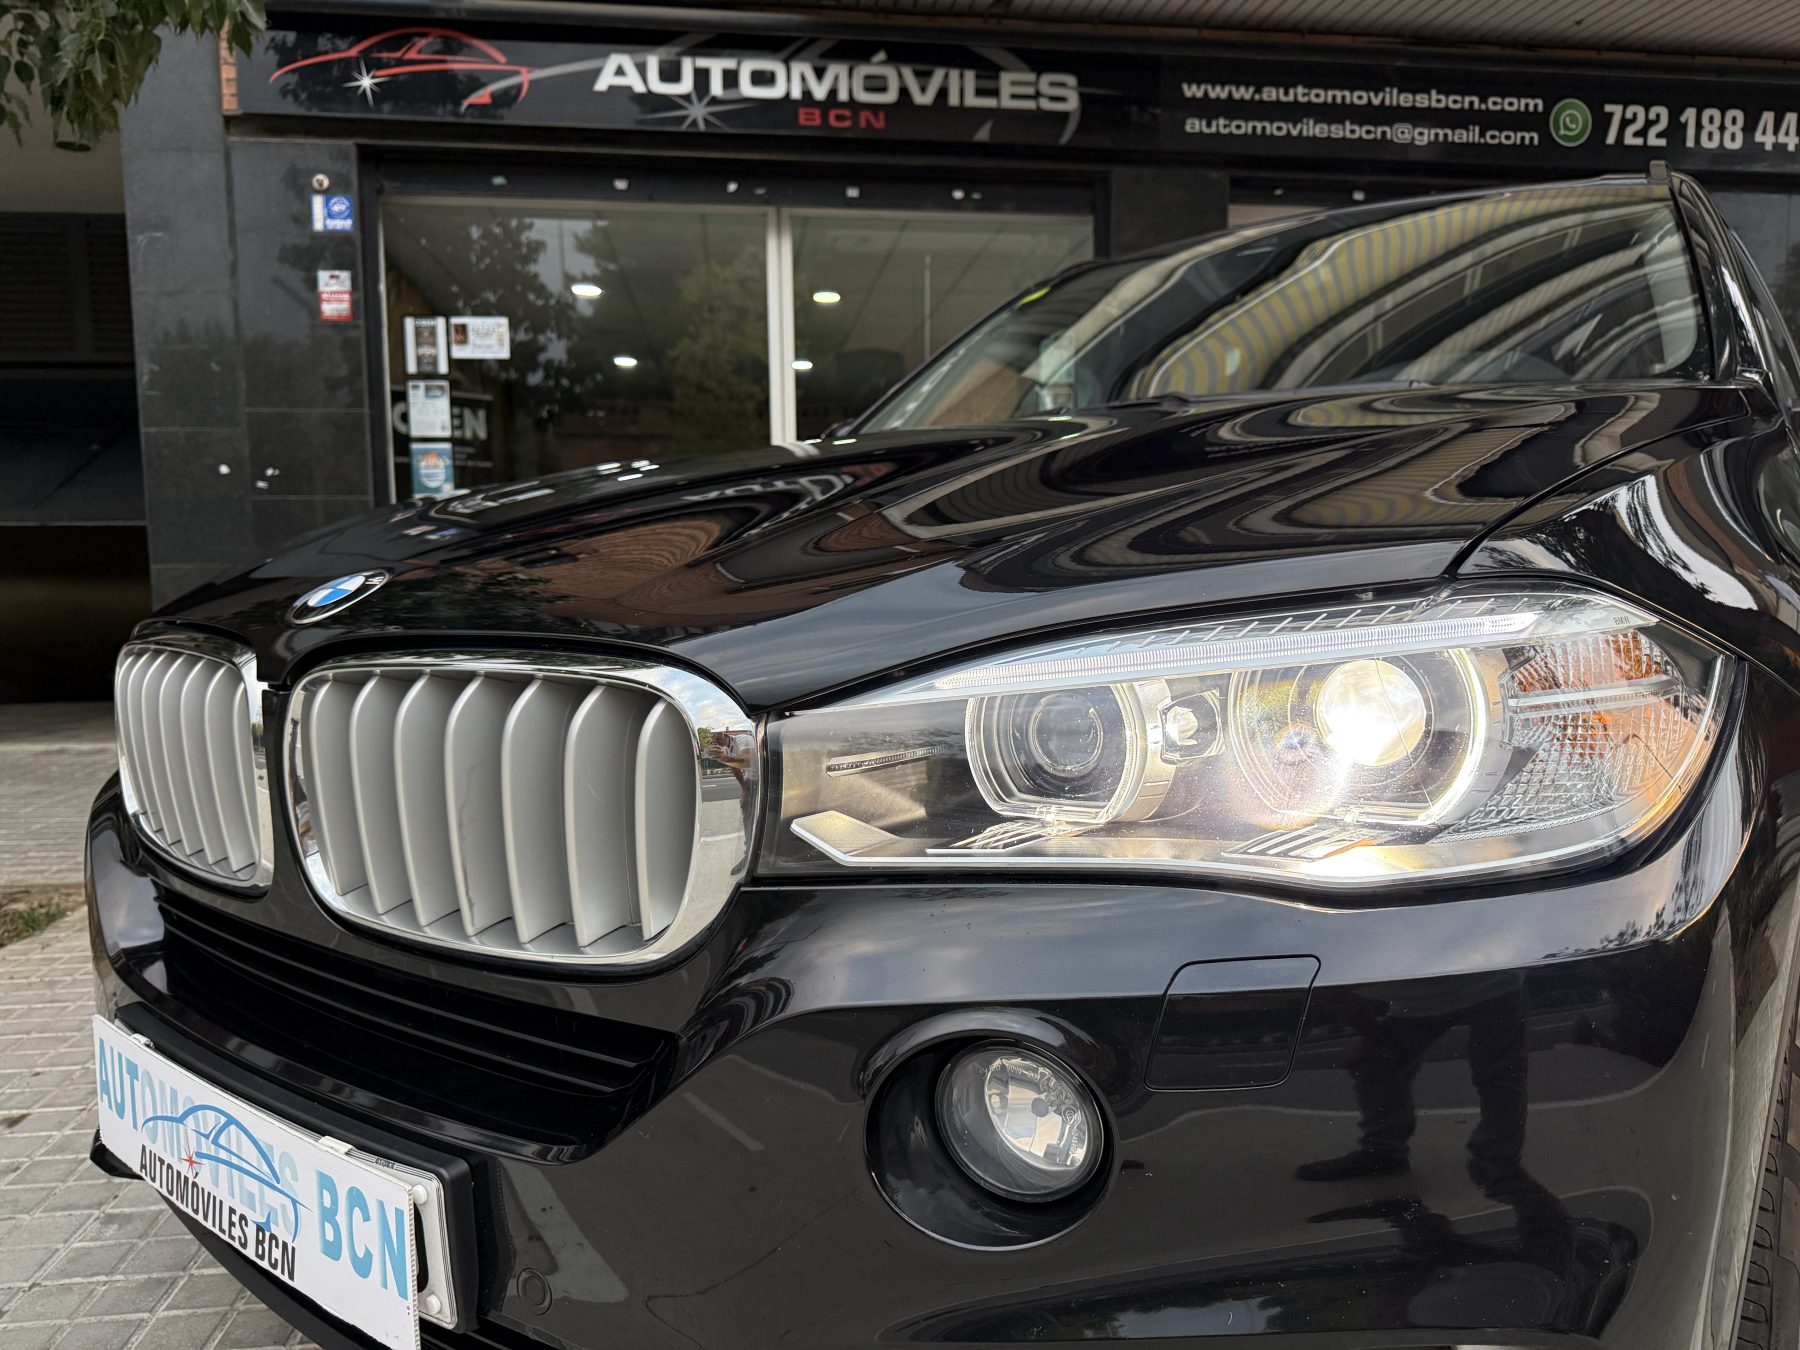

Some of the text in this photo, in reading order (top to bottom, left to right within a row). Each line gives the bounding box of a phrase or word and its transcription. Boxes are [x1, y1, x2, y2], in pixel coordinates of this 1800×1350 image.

[593, 50, 1080, 112] AUTOMÓVILES
[1181, 81, 1544, 114] www.automovilesbcn.com
[797, 107, 887, 129] BCN
[1184, 115, 1540, 148] automovilesbcn@gmail.com
[1603, 103, 1800, 153] 722 188 44
[139, 1143, 297, 1283] AUTOMÓVILES BCN
[315, 1168, 409, 1301] BCN
